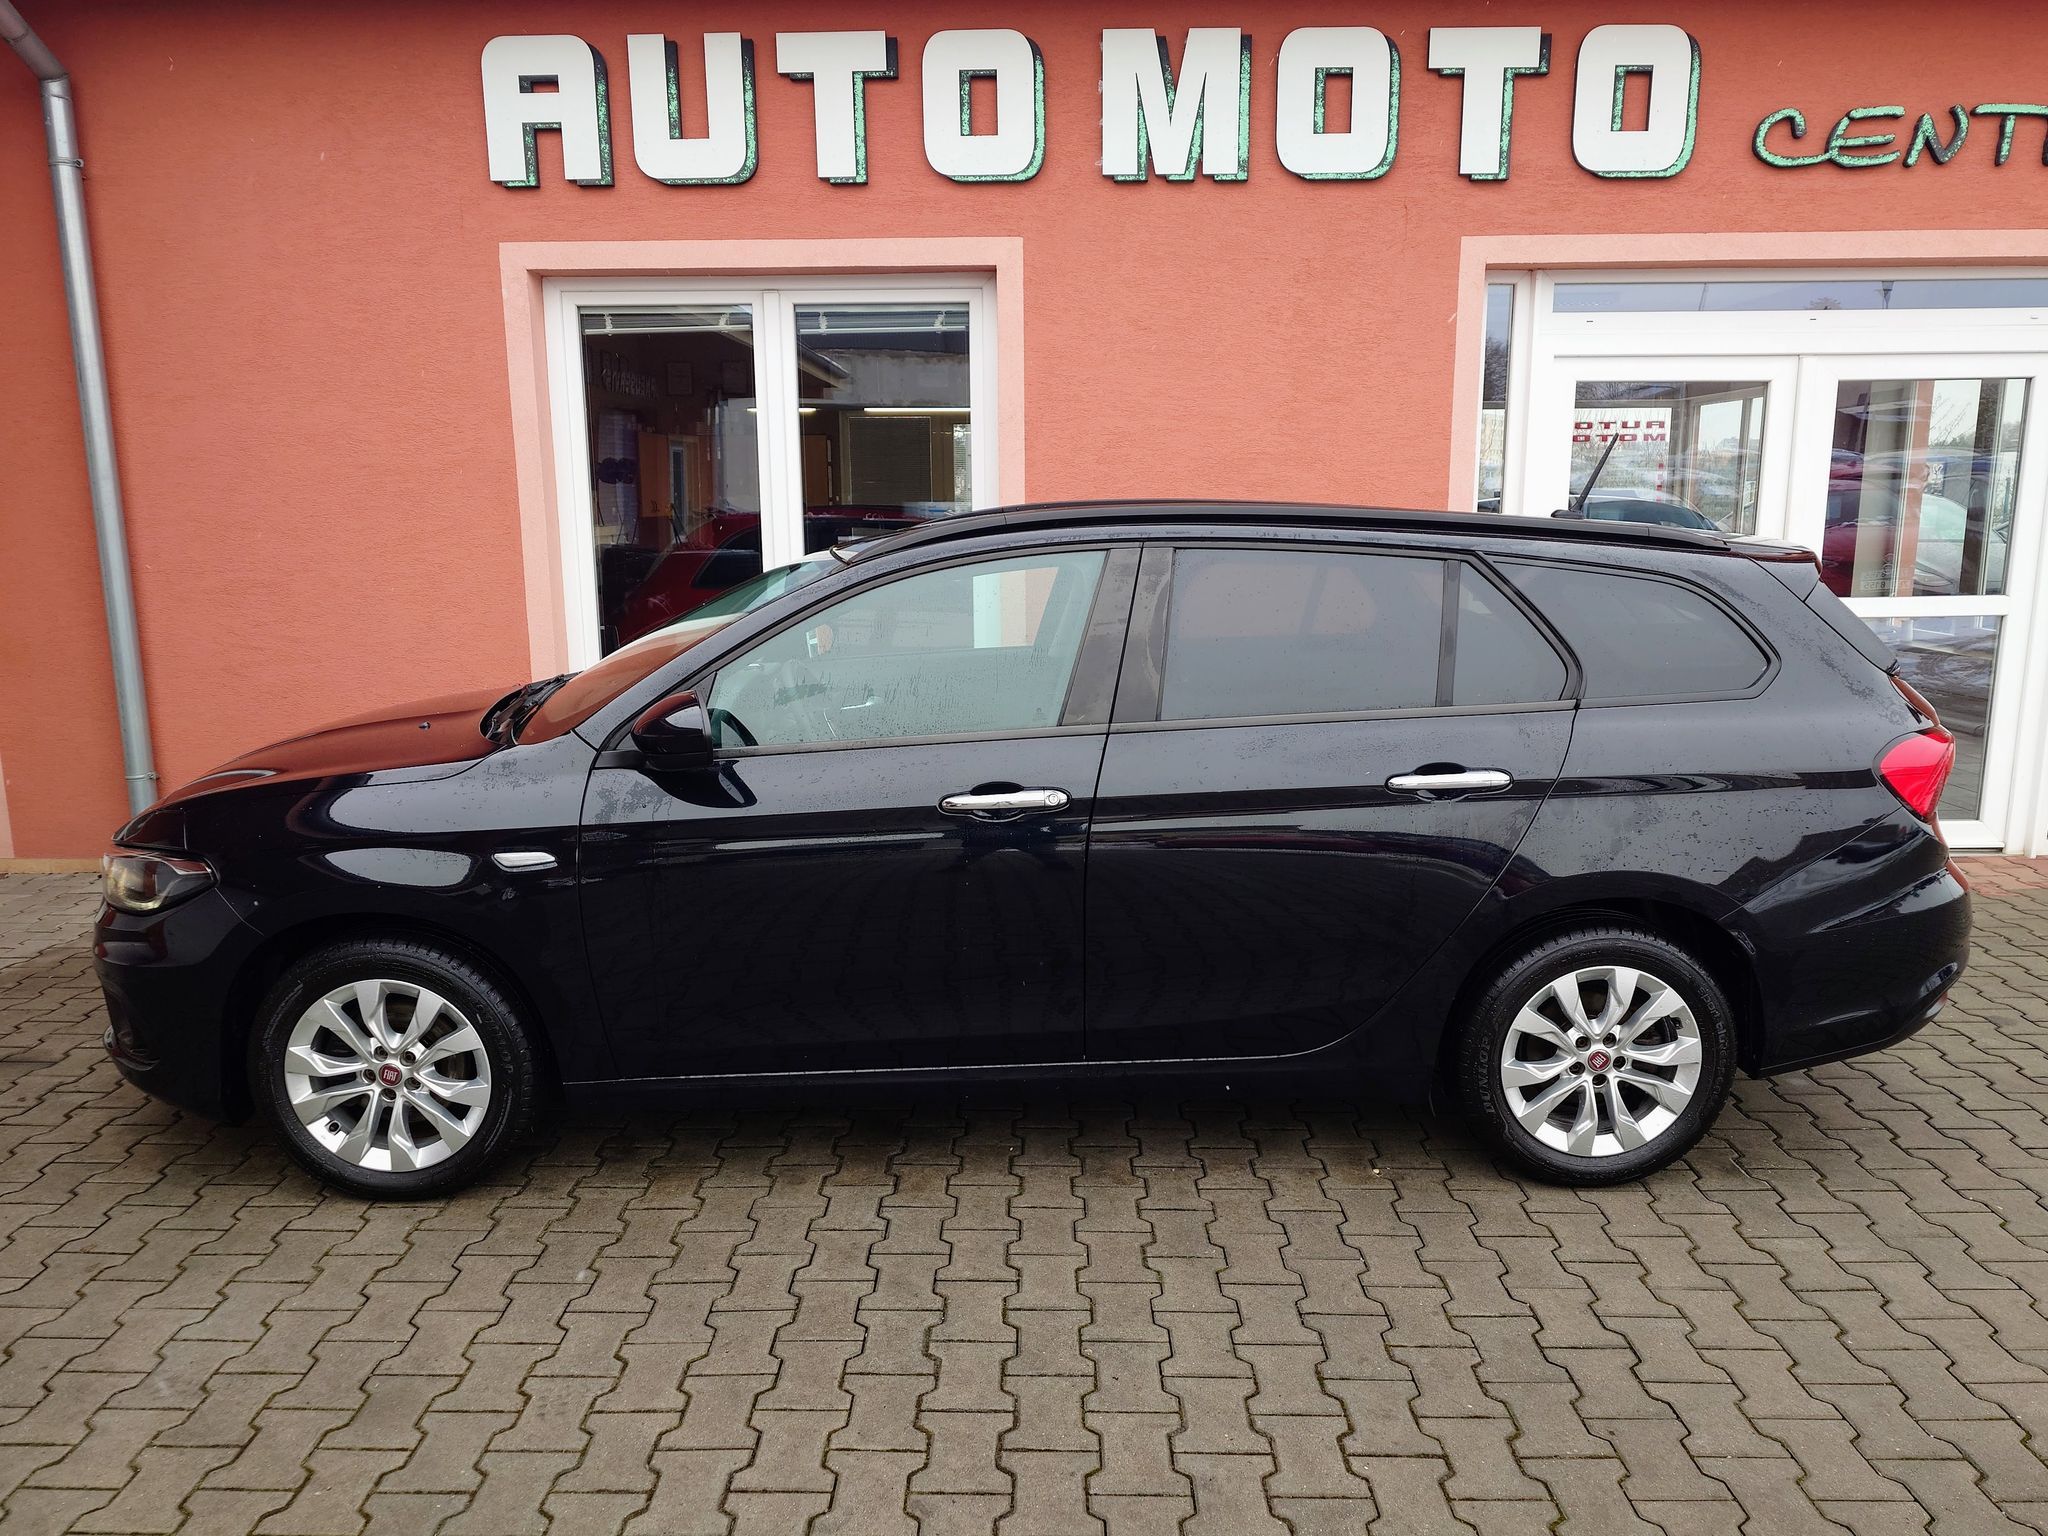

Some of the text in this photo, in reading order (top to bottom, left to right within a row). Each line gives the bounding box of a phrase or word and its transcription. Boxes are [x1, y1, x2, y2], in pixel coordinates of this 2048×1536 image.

[480, 24, 2048, 187] AUTO MOTO CENT
[383, 1069, 398, 1082] FIAT
